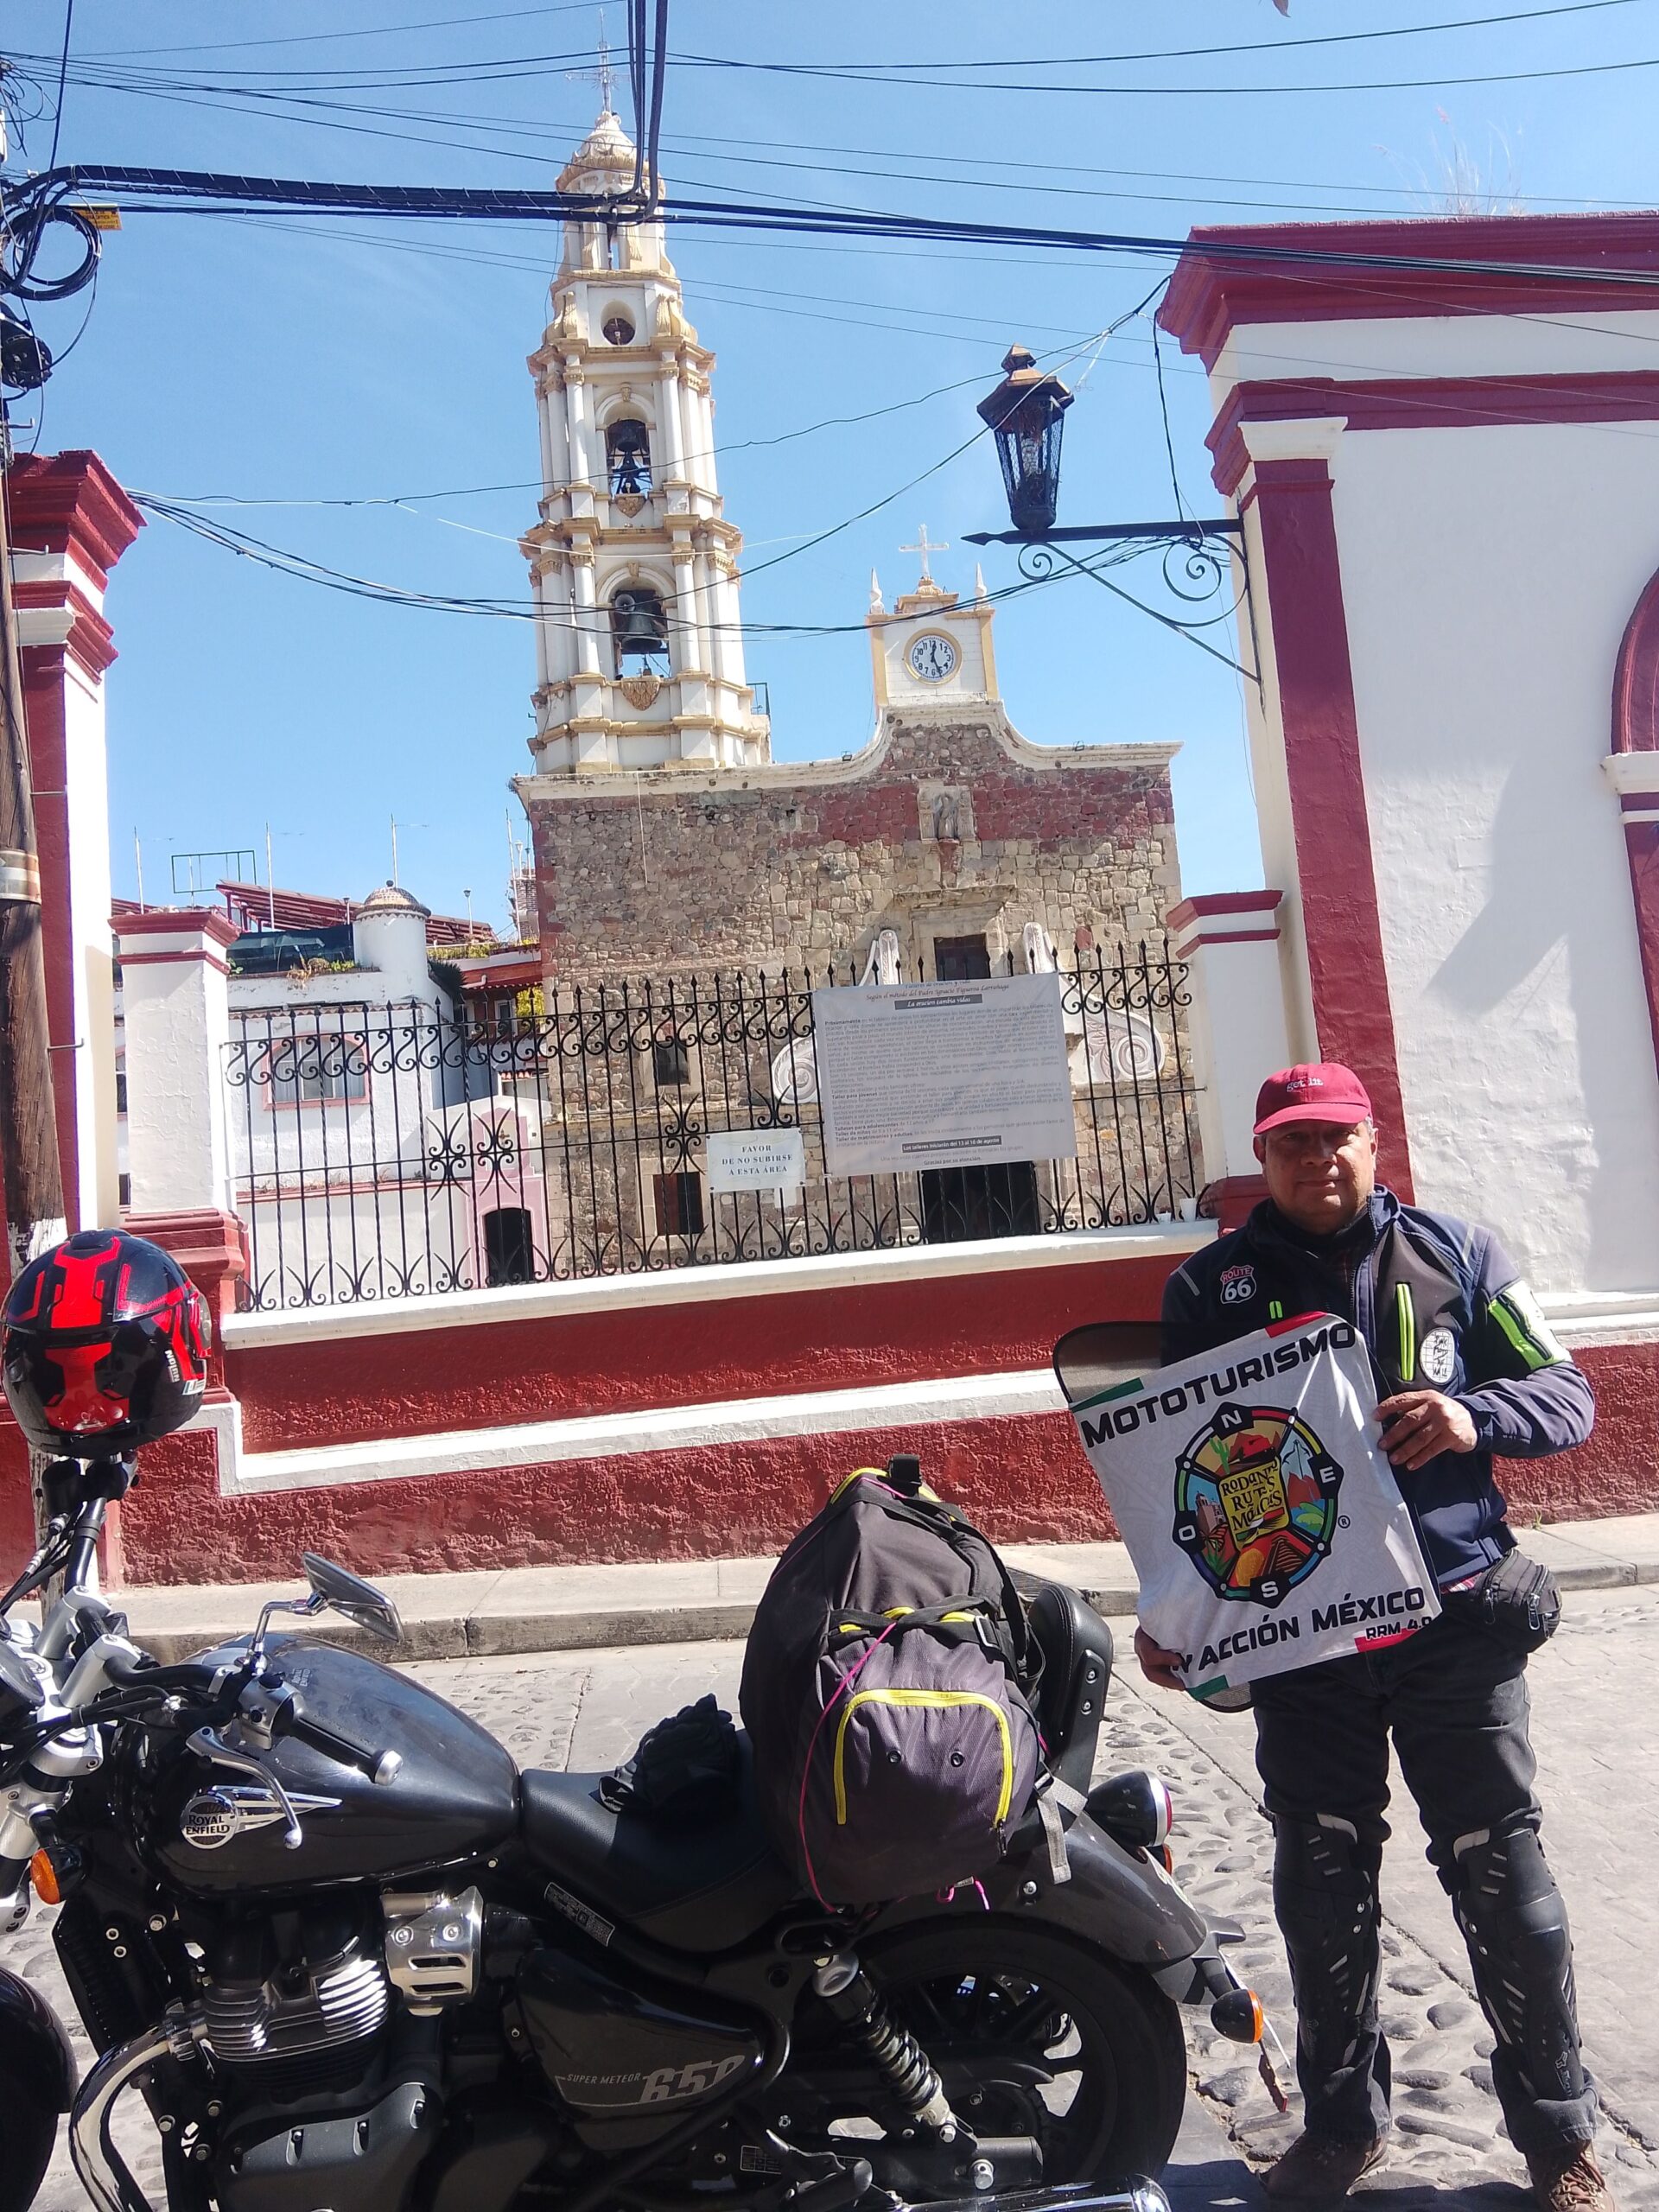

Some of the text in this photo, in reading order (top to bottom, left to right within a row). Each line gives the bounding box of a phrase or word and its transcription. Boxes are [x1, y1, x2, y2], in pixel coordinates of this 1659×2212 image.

[753, 1154, 793, 1163] SUBIRSE
[1223, 1267, 1251, 1281] ROUTE
[1224, 1278, 1252, 1301] 66
[164, 1350, 181, 1382] NOLAN
[1080, 1321, 1357, 1448] MOTOTURISMO
[1221, 1409, 1243, 1428] N
[1319, 1465, 1337, 1484] E
[1179, 1524, 1197, 1542] O
[1261, 1580, 1280, 1599] S
[1198, 1614, 1300, 1671] ACCIÓN
[1312, 1586, 1426, 1633] MÉXICO
[1365, 1616, 1433, 1640] RRM 4.0
[186, 1824, 231, 1835] ENFIELD
[189, 1815, 225, 1826] ROYAL
[567, 2074, 597, 2084] SUPER
[600, 2072, 643, 2084] METEOR
